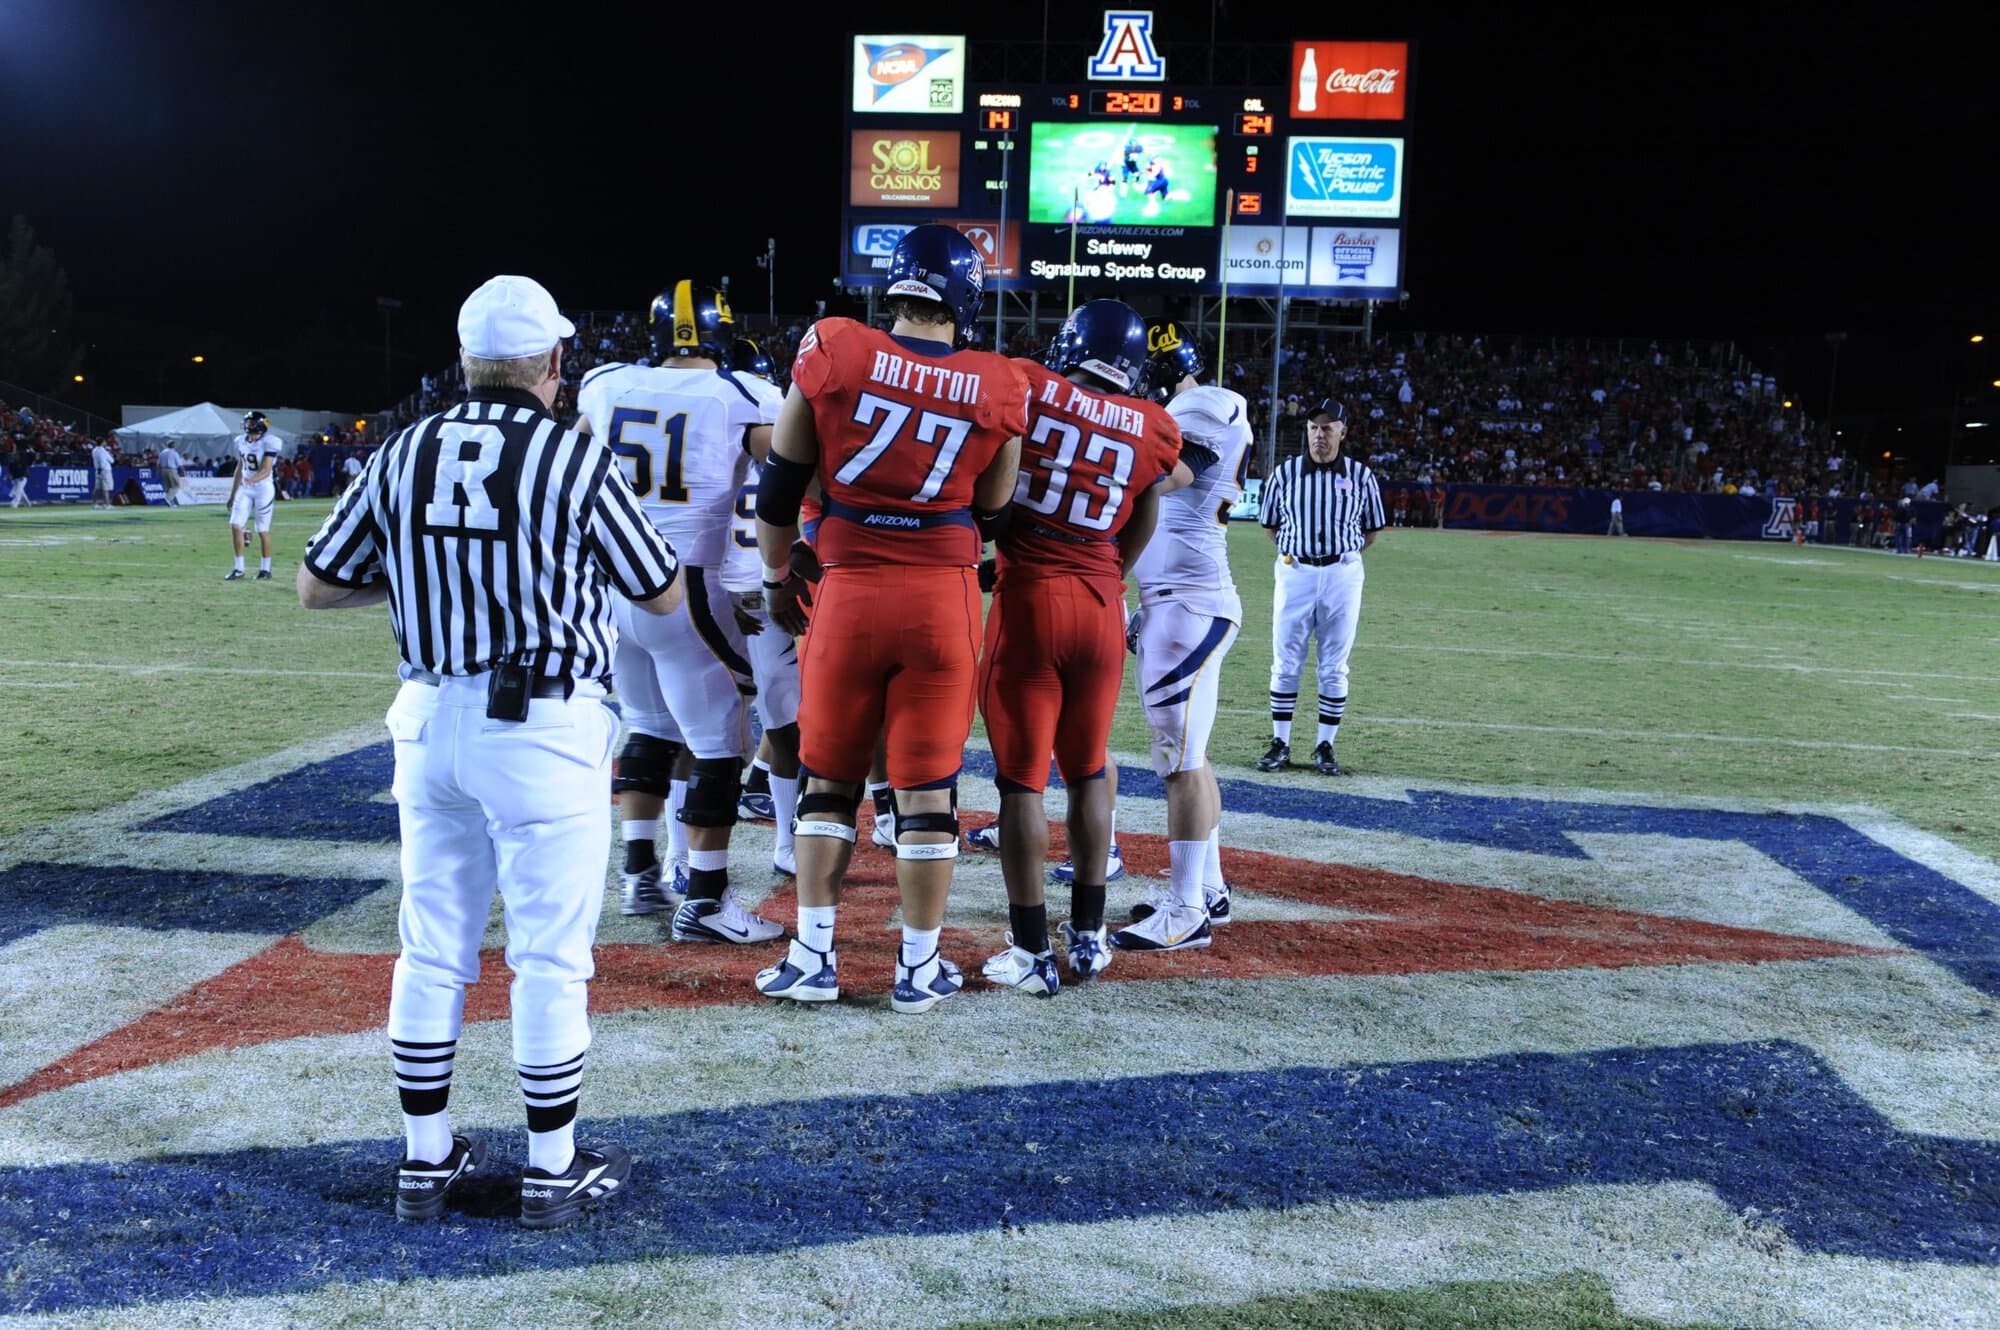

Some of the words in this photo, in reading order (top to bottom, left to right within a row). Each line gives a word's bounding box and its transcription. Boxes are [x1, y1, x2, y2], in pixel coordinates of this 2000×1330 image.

[1088, 10, 1166, 81] A
[1069, 94, 1079, 109] 3
[1106, 91, 1161, 113] 2:20
[1173, 96, 1183, 111] 3
[1242, 115, 1272, 134] 24
[871, 139, 942, 175] SOL
[1246, 156, 1257, 172] 3
[1318, 148, 1373, 165] Tucson
[1322, 164, 1387, 180] Electric
[870, 174, 942, 191] CASINOS
[1327, 178, 1385, 194] Power
[1087, 239, 1152, 259] Safeway
[1030, 260, 1101, 280] Signature
[1104, 262, 1155, 281] Sports
[1157, 263, 1207, 283] Group
[1147, 323, 1182, 352] Cal
[870, 350, 981, 405] BRITTON
[1040, 379, 1061, 408] R.
[1063, 386, 1145, 438] PALMER
[607, 406, 690, 504] 51
[833, 390, 975, 504] 77
[48, 469, 89, 486] ACTION
[426, 421, 506, 531] R
[1012, 414, 1136, 533] 33
[864, 513, 921, 528] ARIZONA
[522, 1188, 554, 1199] eebok
